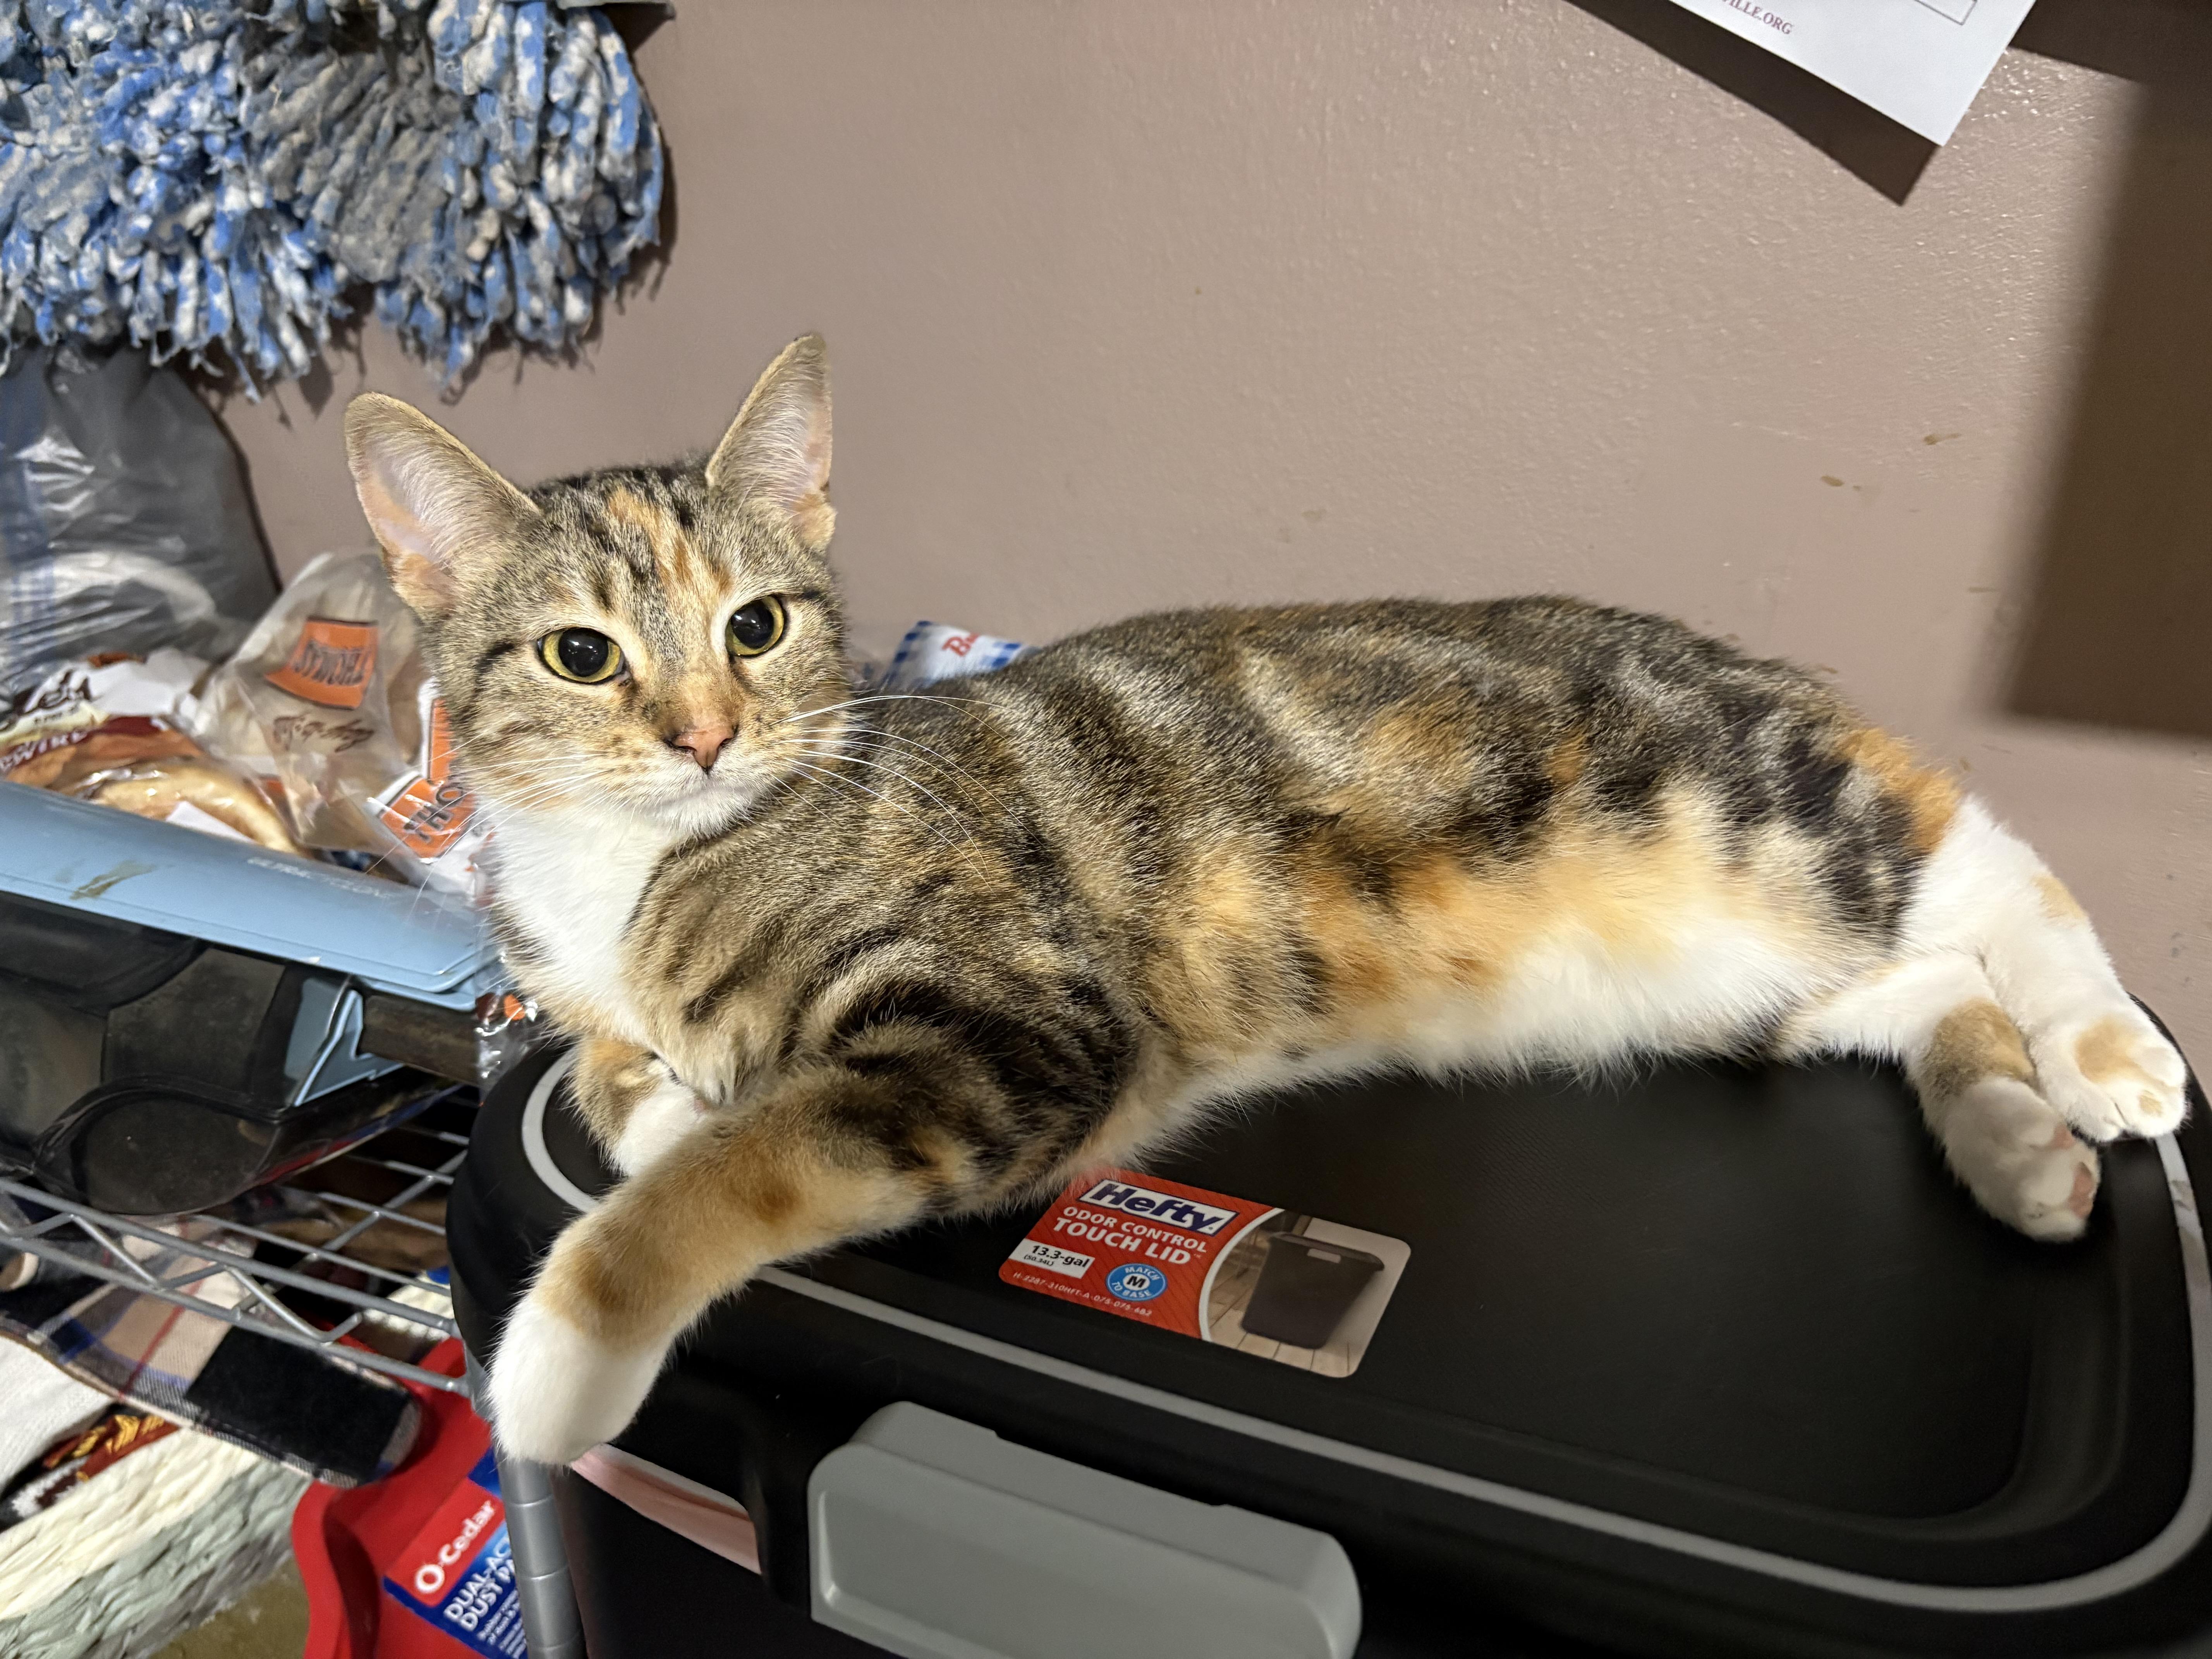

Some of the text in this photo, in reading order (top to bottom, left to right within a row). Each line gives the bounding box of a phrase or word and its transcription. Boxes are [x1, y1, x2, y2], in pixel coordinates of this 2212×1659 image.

[1723, 0, 1795, 34] ILLE.ORG
[403, 785, 465, 843] THO
[1063, 1206, 1207, 1253] ODOR CONTROL
[1090, 1183, 1223, 1231] Hefty
[1032, 1245, 1091, 1268] 13.3-gal
[1053, 1217, 1191, 1264] TOUCH LID
[1111, 1281, 1152, 1298] TO BASE
[1125, 1266, 1160, 1281] MATCH
[1127, 1276, 1147, 1288] M
[443, 1536, 512, 1623] DUAL-AC
[458, 1578, 503, 1633] DUST
